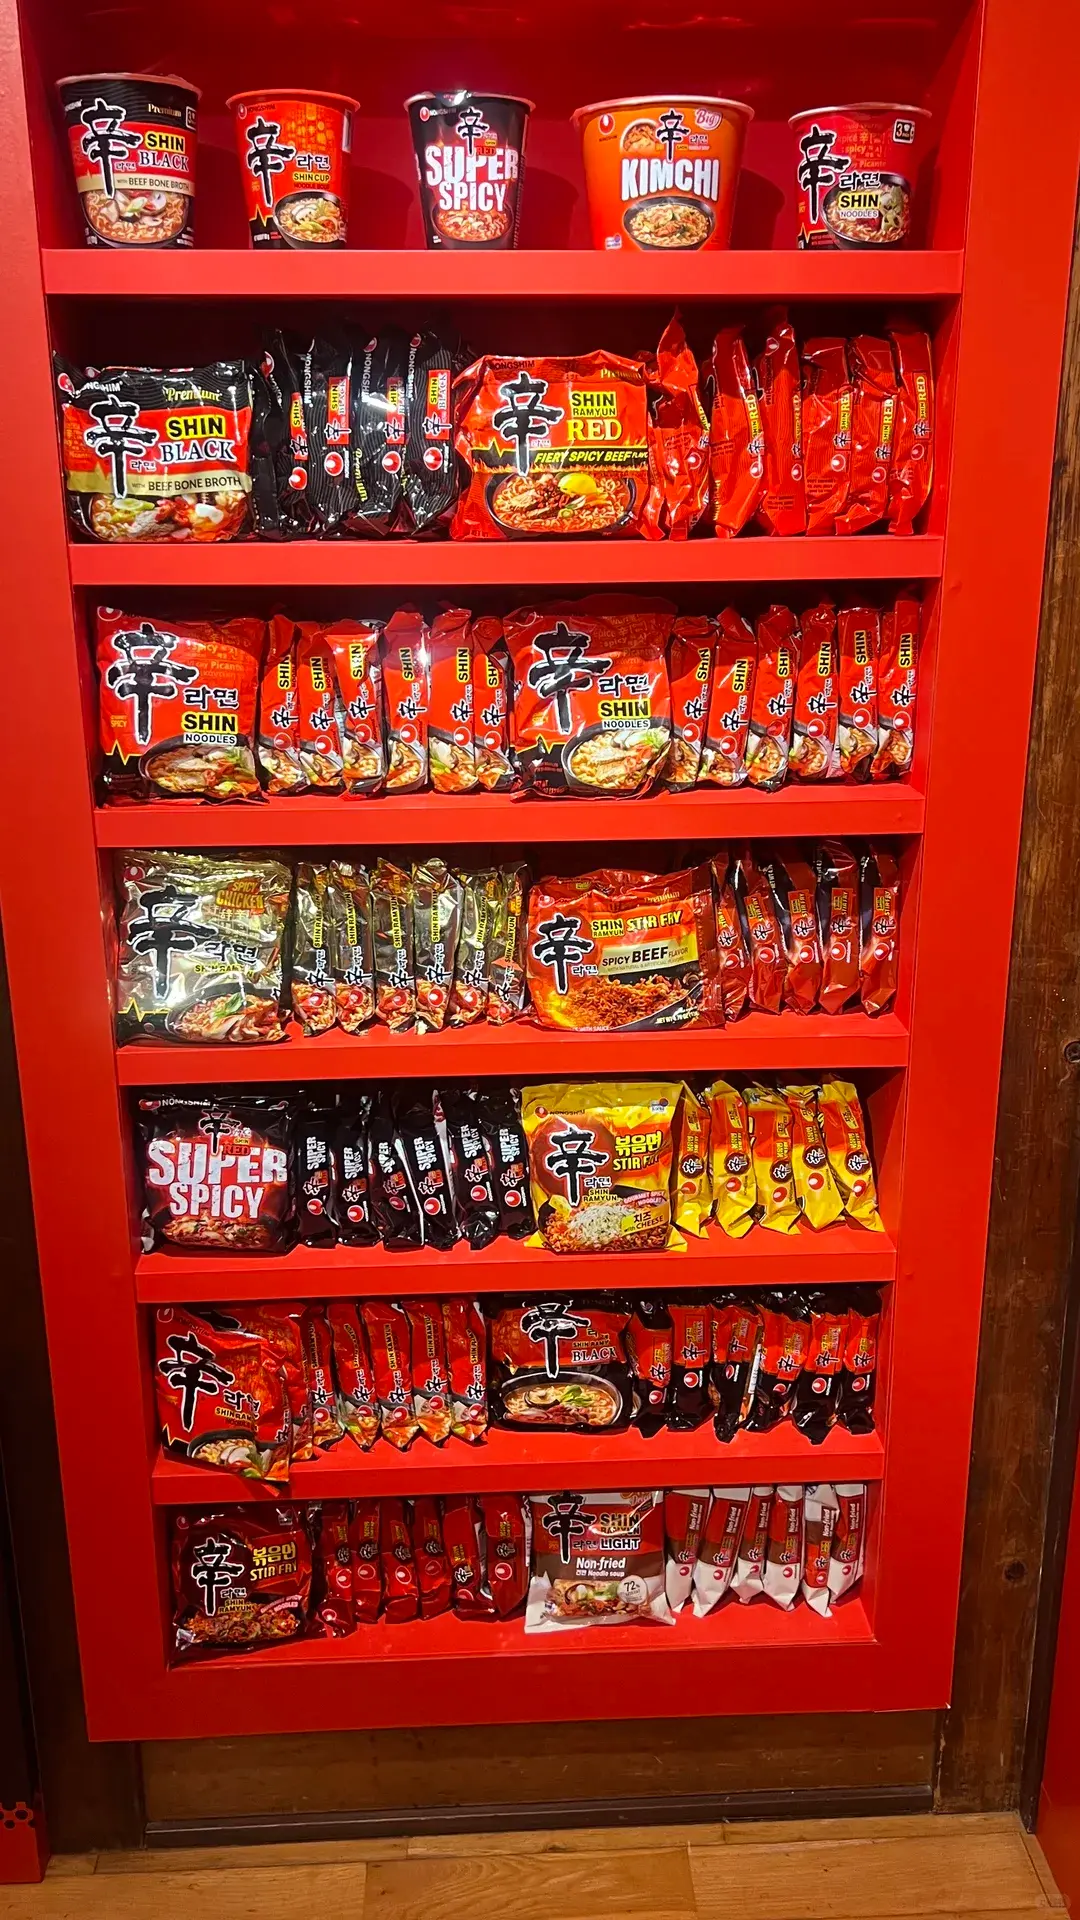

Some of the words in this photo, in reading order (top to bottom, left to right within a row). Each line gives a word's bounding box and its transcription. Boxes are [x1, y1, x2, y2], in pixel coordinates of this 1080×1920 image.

[695, 109, 716, 125] Big
[147, 133, 184, 151] SHIN
[457, 107, 489, 156] 辛
[656, 109, 689, 162] 辛
[82, 98, 141, 198] 辛
[476, 147, 496, 155] RED
[140, 152, 189, 172] BLACK
[247, 117, 296, 206] 辛
[296, 153, 330, 171] 라면
[425, 146, 518, 185] SUPER
[128, 177, 148, 186] BEEF
[149, 178, 170, 188] BONE
[171, 180, 190, 190] BROTH
[294, 173, 311, 181] SHIN
[312, 174, 330, 182] CUP
[621, 159, 719, 201] KIMCHI
[798, 124, 850, 224] 辛
[840, 172, 880, 190] 라면
[438, 182, 506, 211] SPICY
[840, 195, 879, 208] SHIN
[840, 210, 878, 218] NOODLES
[572, 393, 614, 406] SHIN
[917, 376, 926, 401] RED
[573, 408, 616, 416] RAMYUN
[747, 395, 758, 419] RED
[168, 417, 223, 437] SHIN
[423, 414, 452, 435] 辛
[493, 371, 564, 476] 辛
[568, 419, 622, 441] RED
[85, 395, 159, 498] 辛
[161, 441, 236, 462] BLACK
[535, 452, 568, 463] FIERY
[569, 451, 602, 462] SPICY
[604, 451, 632, 461] BEEF
[149, 482, 172, 491] BEEF
[175, 479, 202, 489] BONE
[205, 477, 241, 487] BROTH
[819, 643, 830, 675] SHIN
[856, 631, 866, 663] SHIN
[901, 634, 911, 666] SHIN
[311, 657, 323, 689] SHIN
[352, 645, 362, 678] SHIN
[401, 648, 413, 679] SHIN
[458, 648, 468, 680] SHIN
[698, 649, 709, 679] SHIN
[107, 623, 199, 745] 辛
[528, 621, 612, 734] 辛
[599, 674, 649, 695] 라면
[734, 660, 747, 691] SHIN
[183, 687, 238, 708] 라면
[600, 702, 648, 717] SHIN
[184, 714, 236, 731] SHIN
[185, 735, 236, 744] NOODLES
[232, 882, 257, 891] SPICY
[217, 890, 263, 909] CHICKEN
[392, 897, 400, 930] RAMYUN
[592, 920, 623, 930] SHIN
[627, 916, 658, 931] STIR
[660, 911, 682, 926] FRY
[127, 884, 218, 1000] 辛
[507, 918, 516, 946] RAMYUN
[533, 913, 594, 994] 辛
[602, 956, 630, 966] SPICY
[632, 947, 668, 962] BEEF
[669, 948, 688, 956] FLAVOR
[199, 1108, 241, 1155] 辛
[461, 1124, 476, 1158] SUPER
[471, 1128, 482, 1150] SPICY
[223, 1146, 250, 1155] RED
[307, 1136, 318, 1170] SUPER
[317, 1141, 326, 1163] SPICY
[414, 1137, 431, 1170] SUPER
[425, 1140, 437, 1163] SPICY
[500, 1128, 513, 1162] SUPER
[510, 1134, 519, 1156] SPICY
[615, 1131, 662, 1157] 볶음면
[149, 1140, 287, 1185] SUPER
[344, 1147, 356, 1179] SUPER
[545, 1124, 609, 1207] 辛
[613, 1159, 641, 1171] STIR
[584, 1177, 611, 1187] 라면
[170, 1183, 264, 1218] SPICY
[624, 1194, 650, 1204] GOURMET
[634, 1212, 651, 1223] 치즈
[636, 1217, 663, 1229] CHEESE
[572, 1347, 616, 1362] BLACK
[158, 1331, 235, 1432] 辛
[216, 1408, 234, 1417] SHIN
[601, 1514, 640, 1528] SHIN
[689, 1502, 699, 1530] Non-fried
[726, 1506, 736, 1533] Non-fried
[758, 1502, 767, 1528] Non-fried
[788, 1508, 796, 1533] Non-fried
[822, 1509, 830, 1537] Non-fried
[543, 1491, 596, 1564] 辛
[253, 1542, 297, 1566] 볶음면
[601, 1539, 640, 1550] LIGHT
[250, 1567, 275, 1581] STIR
[279, 1562, 297, 1575] FRY
[576, 1557, 626, 1570] Non-fried
[192, 1537, 244, 1616] 辛
[624, 1581, 636, 1592] 72
